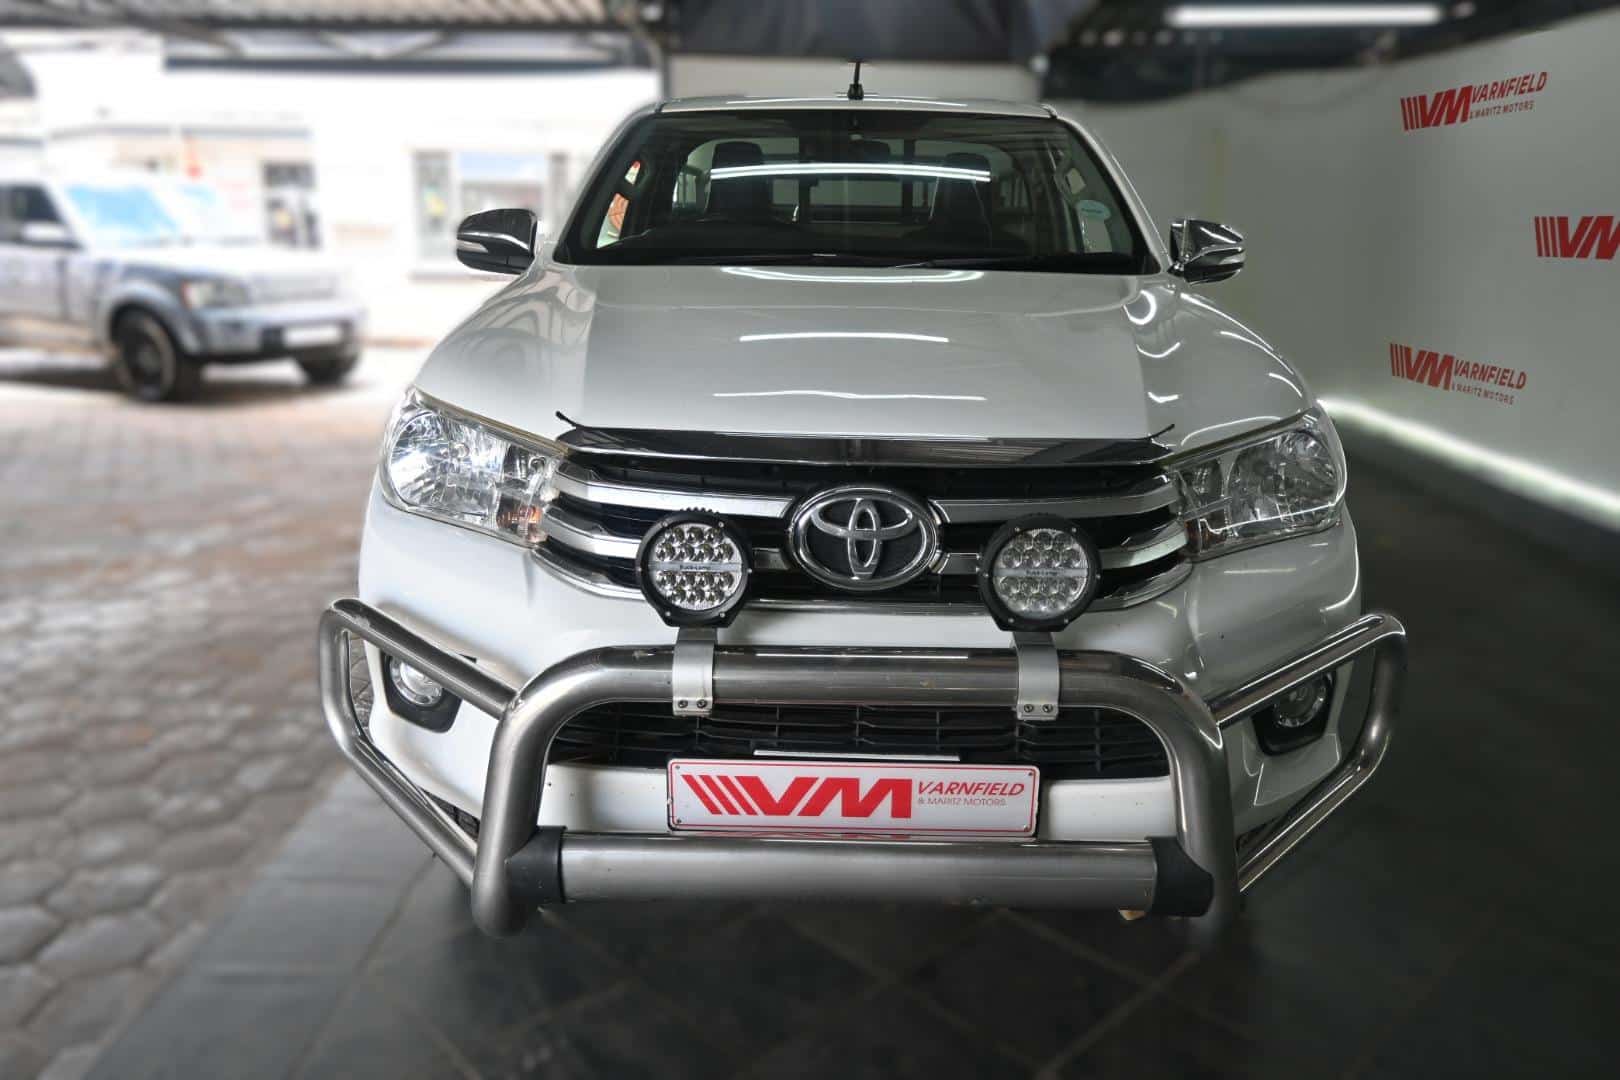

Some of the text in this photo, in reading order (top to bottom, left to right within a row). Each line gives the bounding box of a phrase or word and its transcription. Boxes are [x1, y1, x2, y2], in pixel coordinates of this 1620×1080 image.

[1472, 71, 1548, 104] VARNFIELD
[1418, 85, 1473, 128] VM
[1503, 100, 1535, 113] MOTORS
[1404, 346, 1455, 391] VM
[1454, 359, 1527, 390] VARNFIELD
[733, 775, 913, 819] VM
[918, 781, 1025, 796] VARNFIELD
[963, 797, 1007, 807] MOTORS
